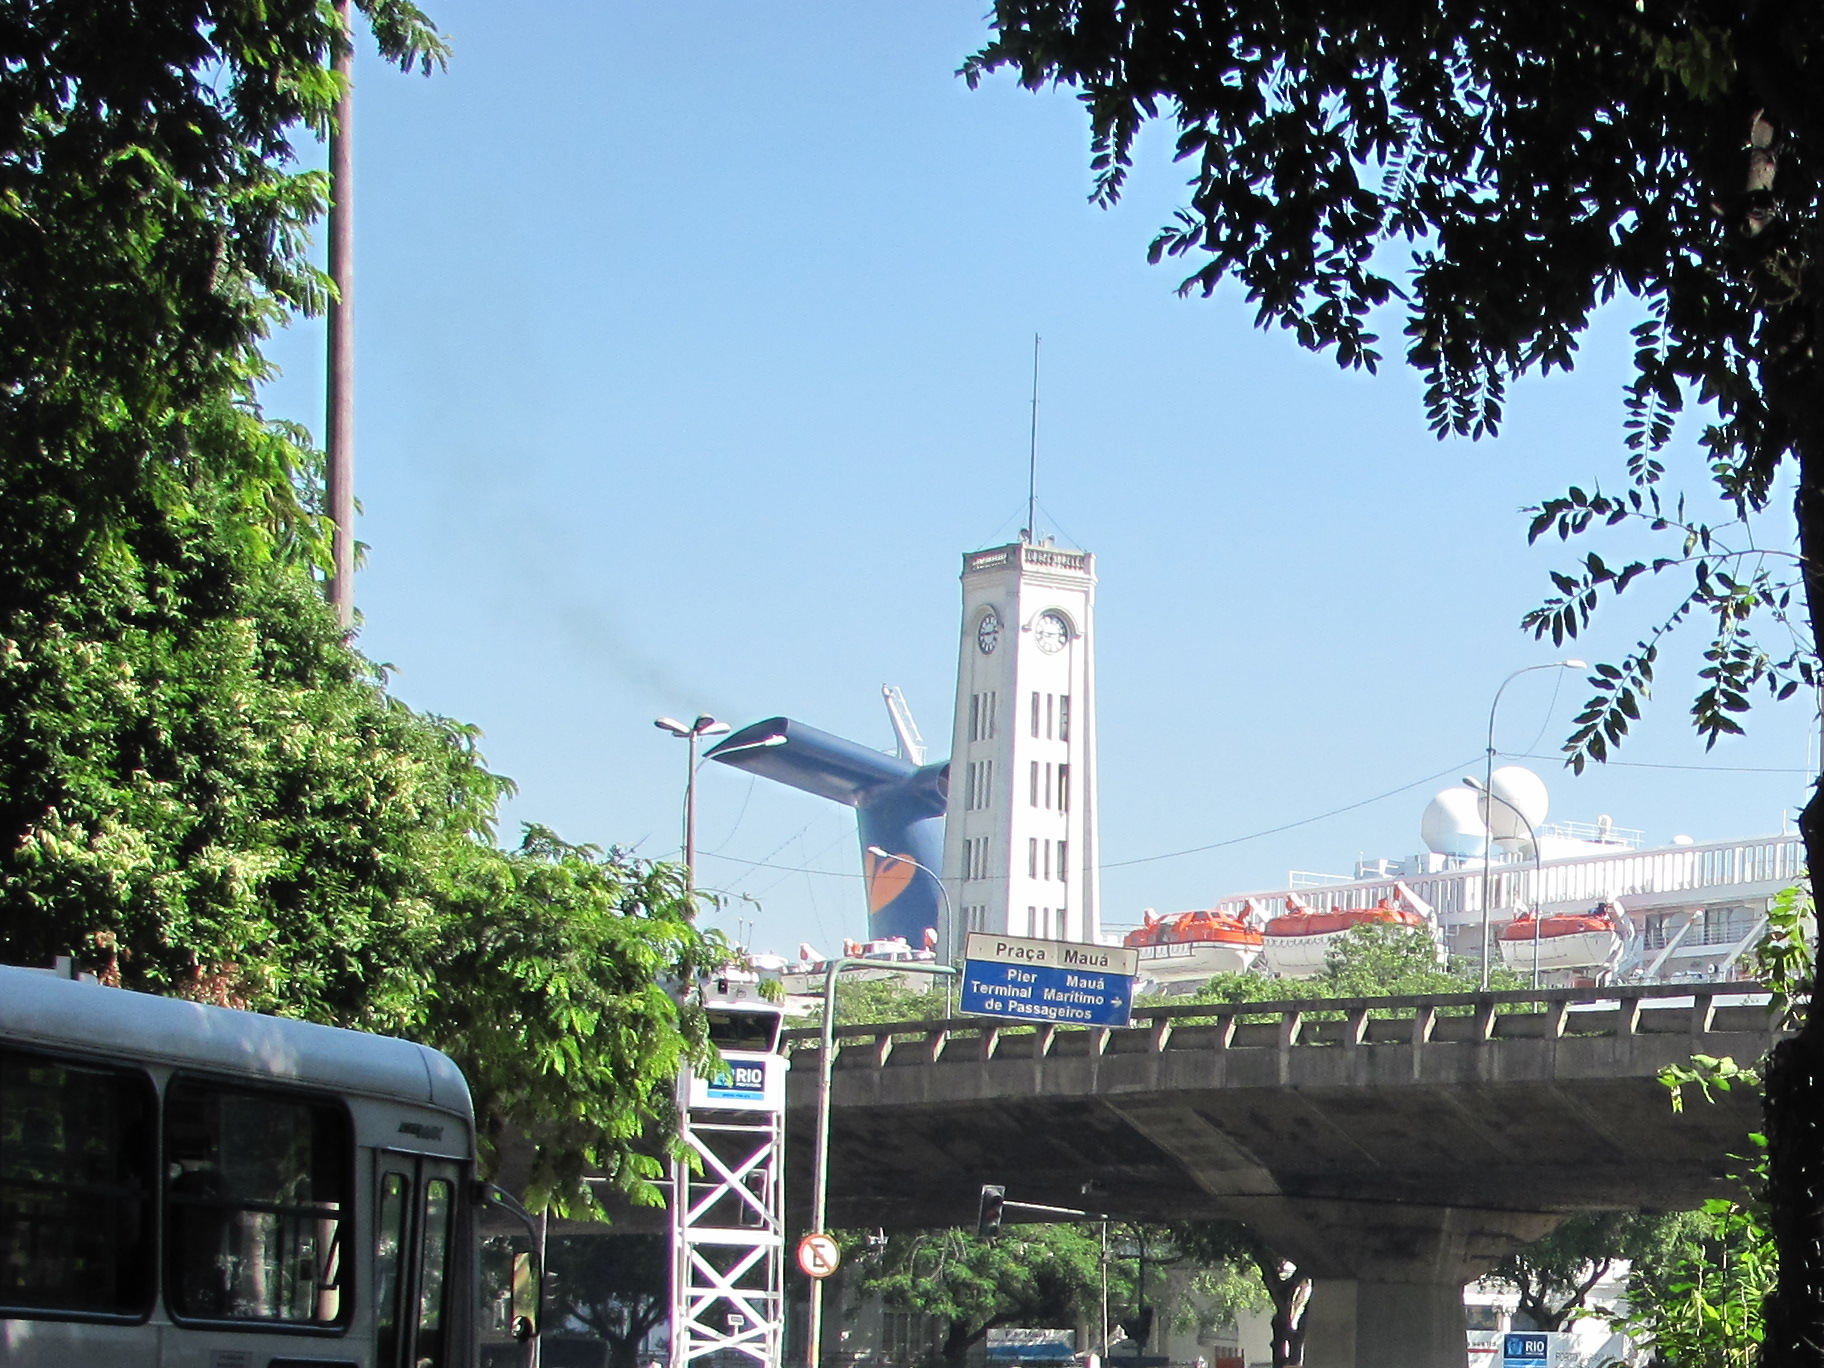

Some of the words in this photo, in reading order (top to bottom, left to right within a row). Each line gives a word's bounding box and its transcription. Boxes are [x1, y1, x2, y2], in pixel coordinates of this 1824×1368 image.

[996, 943, 1046, 962] Praça
[1064, 949, 1109, 967] Mauá
[1007, 968, 1038, 983] Pier
[1066, 974, 1105, 990] Mauá
[971, 980, 1032, 999] Terminal
[1044, 987, 1104, 1005] Marítimo
[985, 998, 1002, 1011] de
[1008, 1000, 1092, 1020] Passageiros
[736, 1068, 762, 1083] RIO
[1525, 1340, 1545, 1352] RIO
